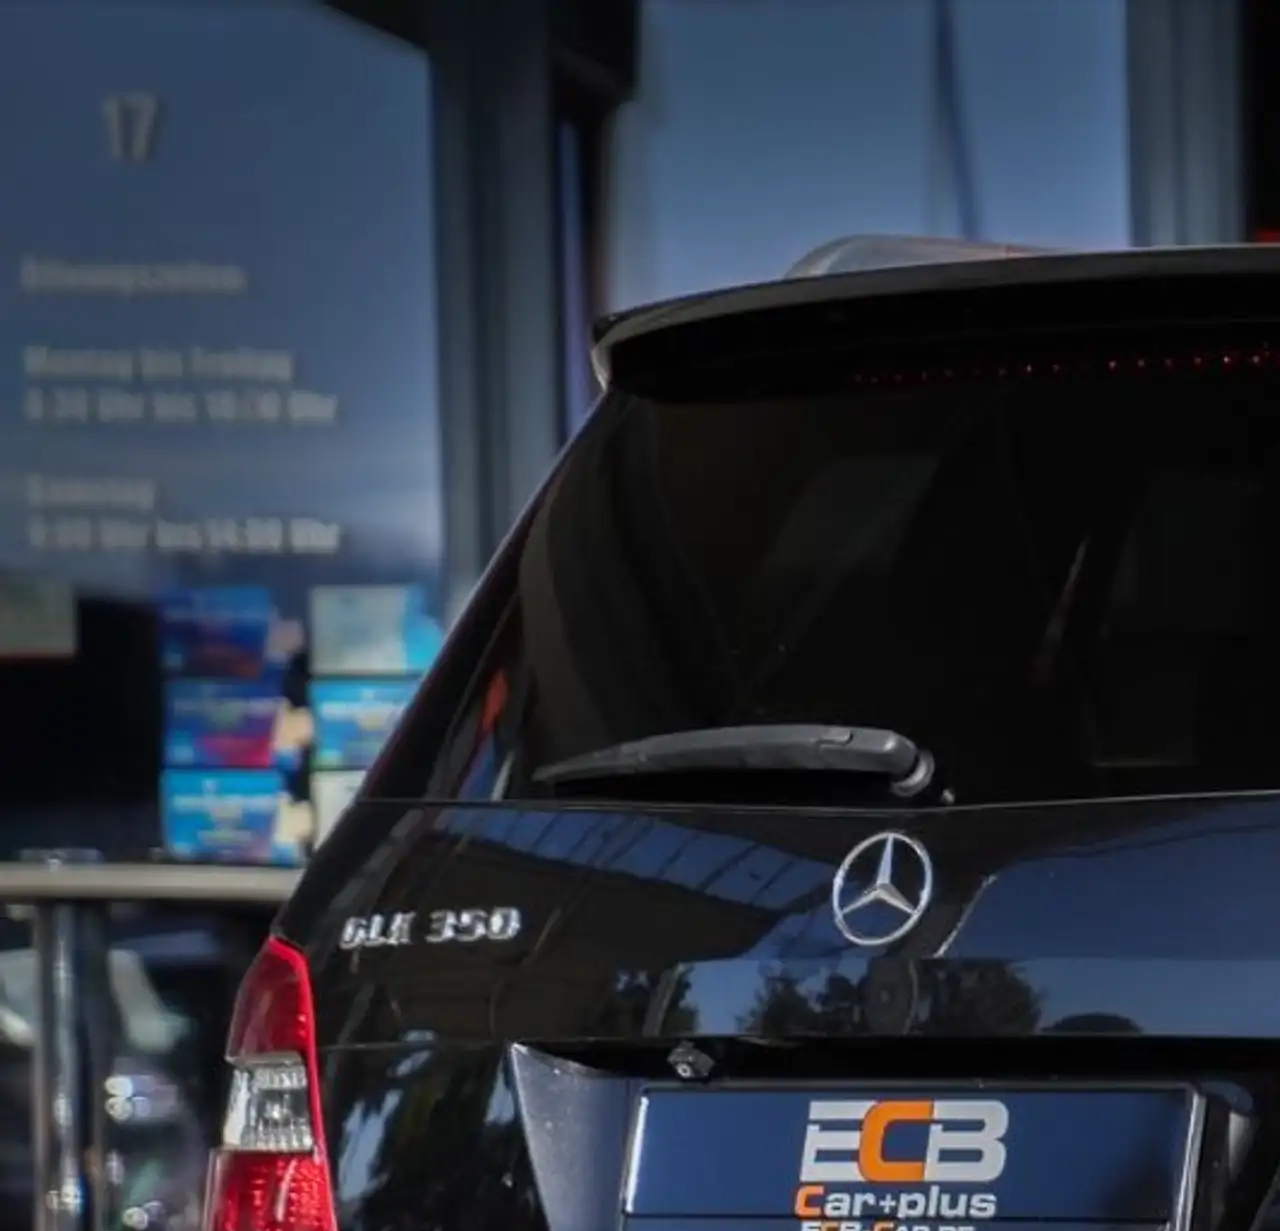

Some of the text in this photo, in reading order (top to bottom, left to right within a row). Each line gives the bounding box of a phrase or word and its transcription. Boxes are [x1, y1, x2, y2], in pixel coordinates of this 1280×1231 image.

[102, 92, 158, 161] 17
[340, 906, 522, 949] GLK 350
[800, 1099, 1009, 1182] ECB
[794, 1184, 997, 1219] Car+plus
